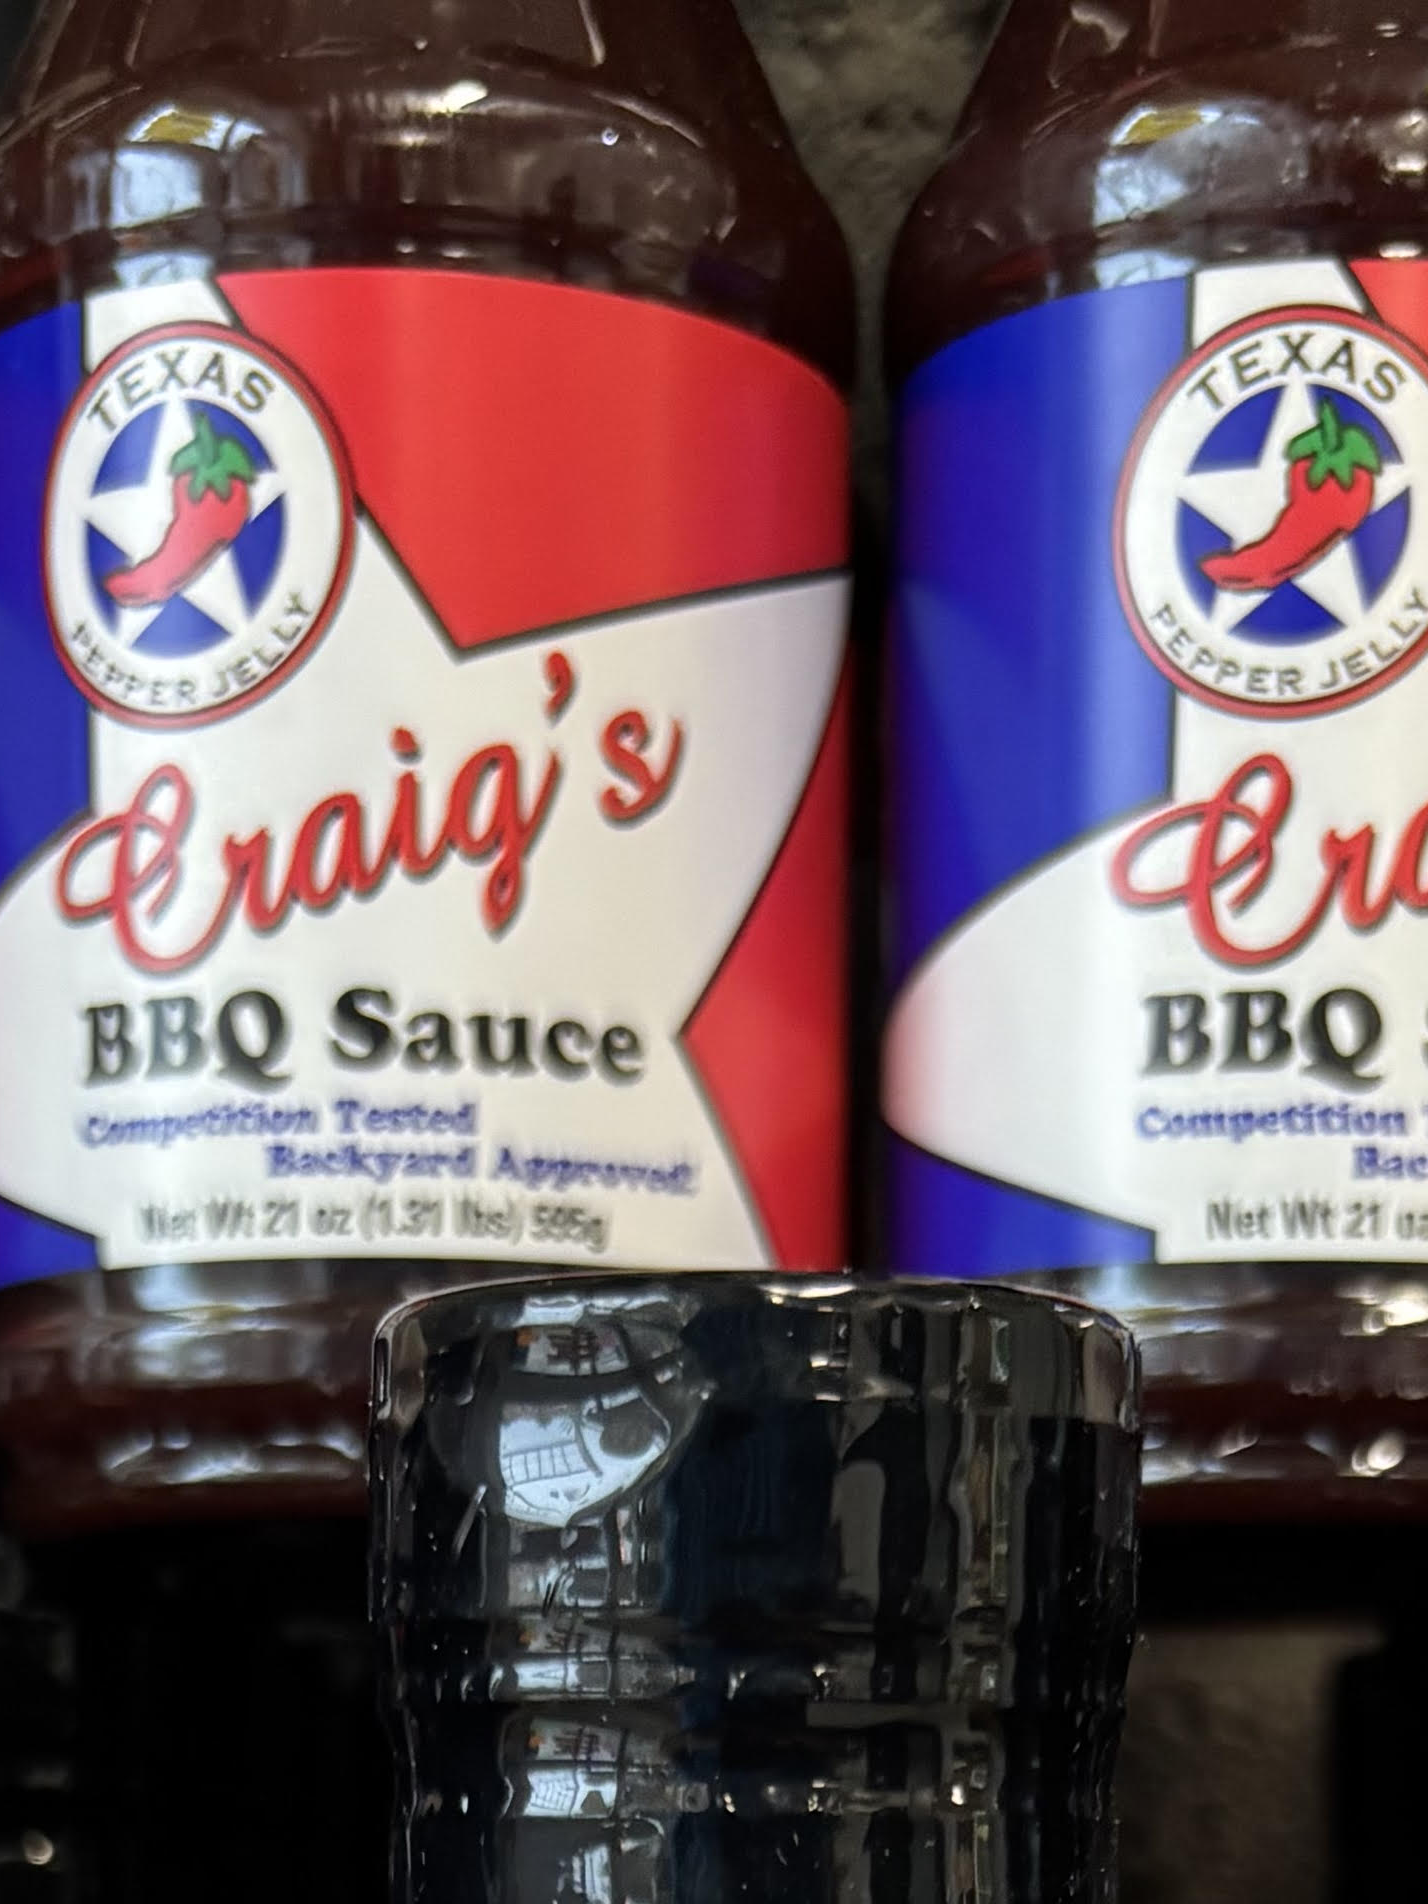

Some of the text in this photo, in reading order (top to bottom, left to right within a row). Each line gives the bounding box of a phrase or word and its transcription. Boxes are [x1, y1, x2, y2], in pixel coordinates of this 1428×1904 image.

[88, 347, 274, 435] TEXAS
[1186, 333, 1407, 412] TEXAS
[71, 591, 307, 709] PEPPER JELLY
[1149, 604, 1304, 696] PEPPER
[56, 650, 683, 973] Craig's
[82, 988, 645, 1089] BBQ Sauce
[1140, 988, 1385, 1093] BBQ
[82, 1099, 478, 1147] Competition Tested
[268, 1143, 476, 1183] Backyard
[1138, 1104, 1407, 1143] Competition
[262, 1201, 304, 1238] 21
[311, 1205, 352, 1237] oz
[365, 1202, 443, 1242] (1.31
[455, 1203, 523, 1245] lbs)
[1206, 1201, 1270, 1240] Net
[1278, 1202, 1336, 1241] Wt
[1343, 1202, 1382, 1240] 21
